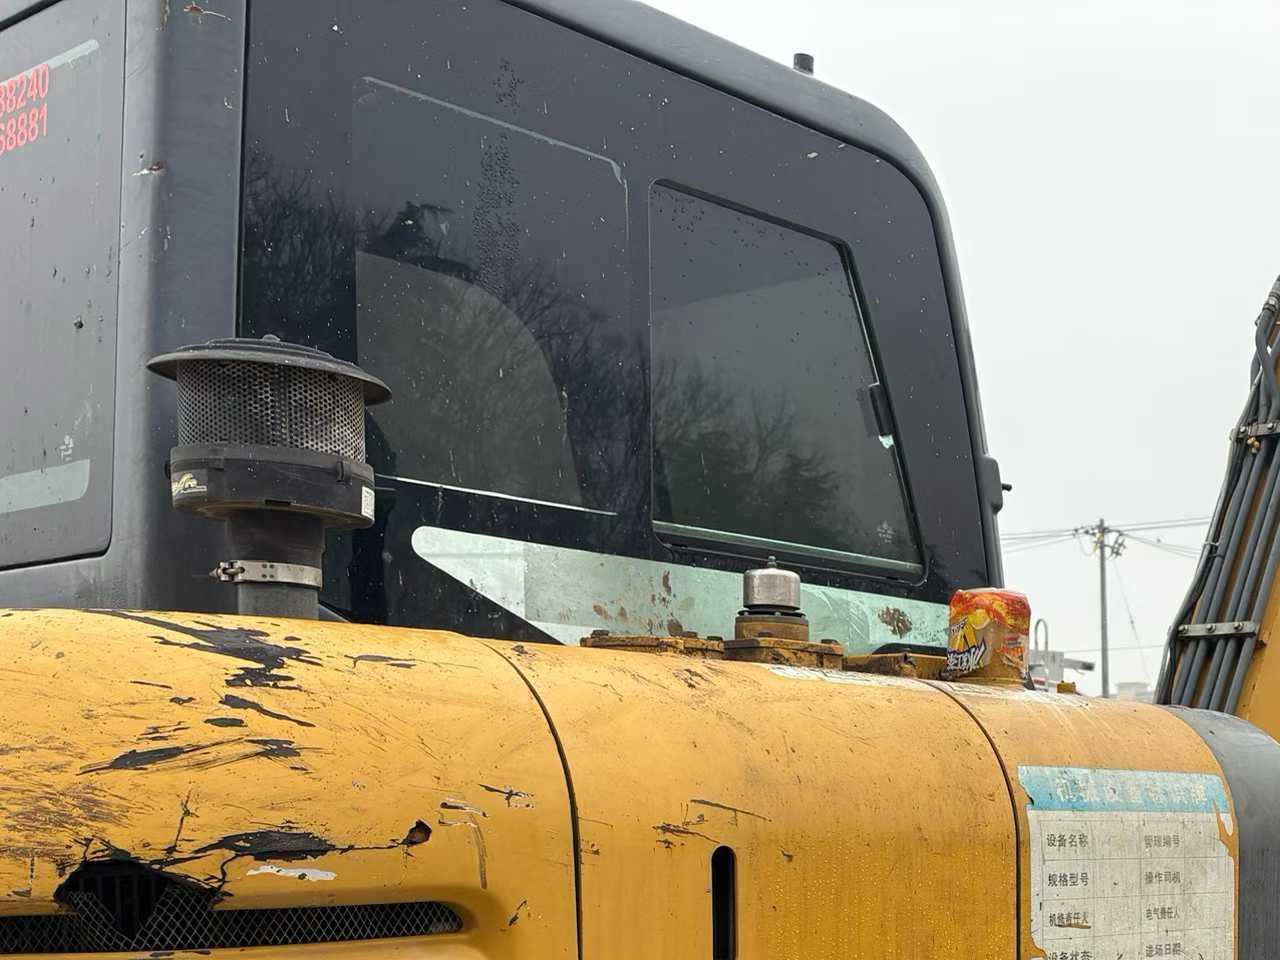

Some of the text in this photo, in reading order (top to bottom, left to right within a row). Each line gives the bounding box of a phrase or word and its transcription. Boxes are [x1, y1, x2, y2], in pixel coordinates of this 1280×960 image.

[1046, 833, 1089, 848] 设备名称
[1047, 872, 1089, 887] 规格型号
[1144, 871, 1182, 885] 操作司机
